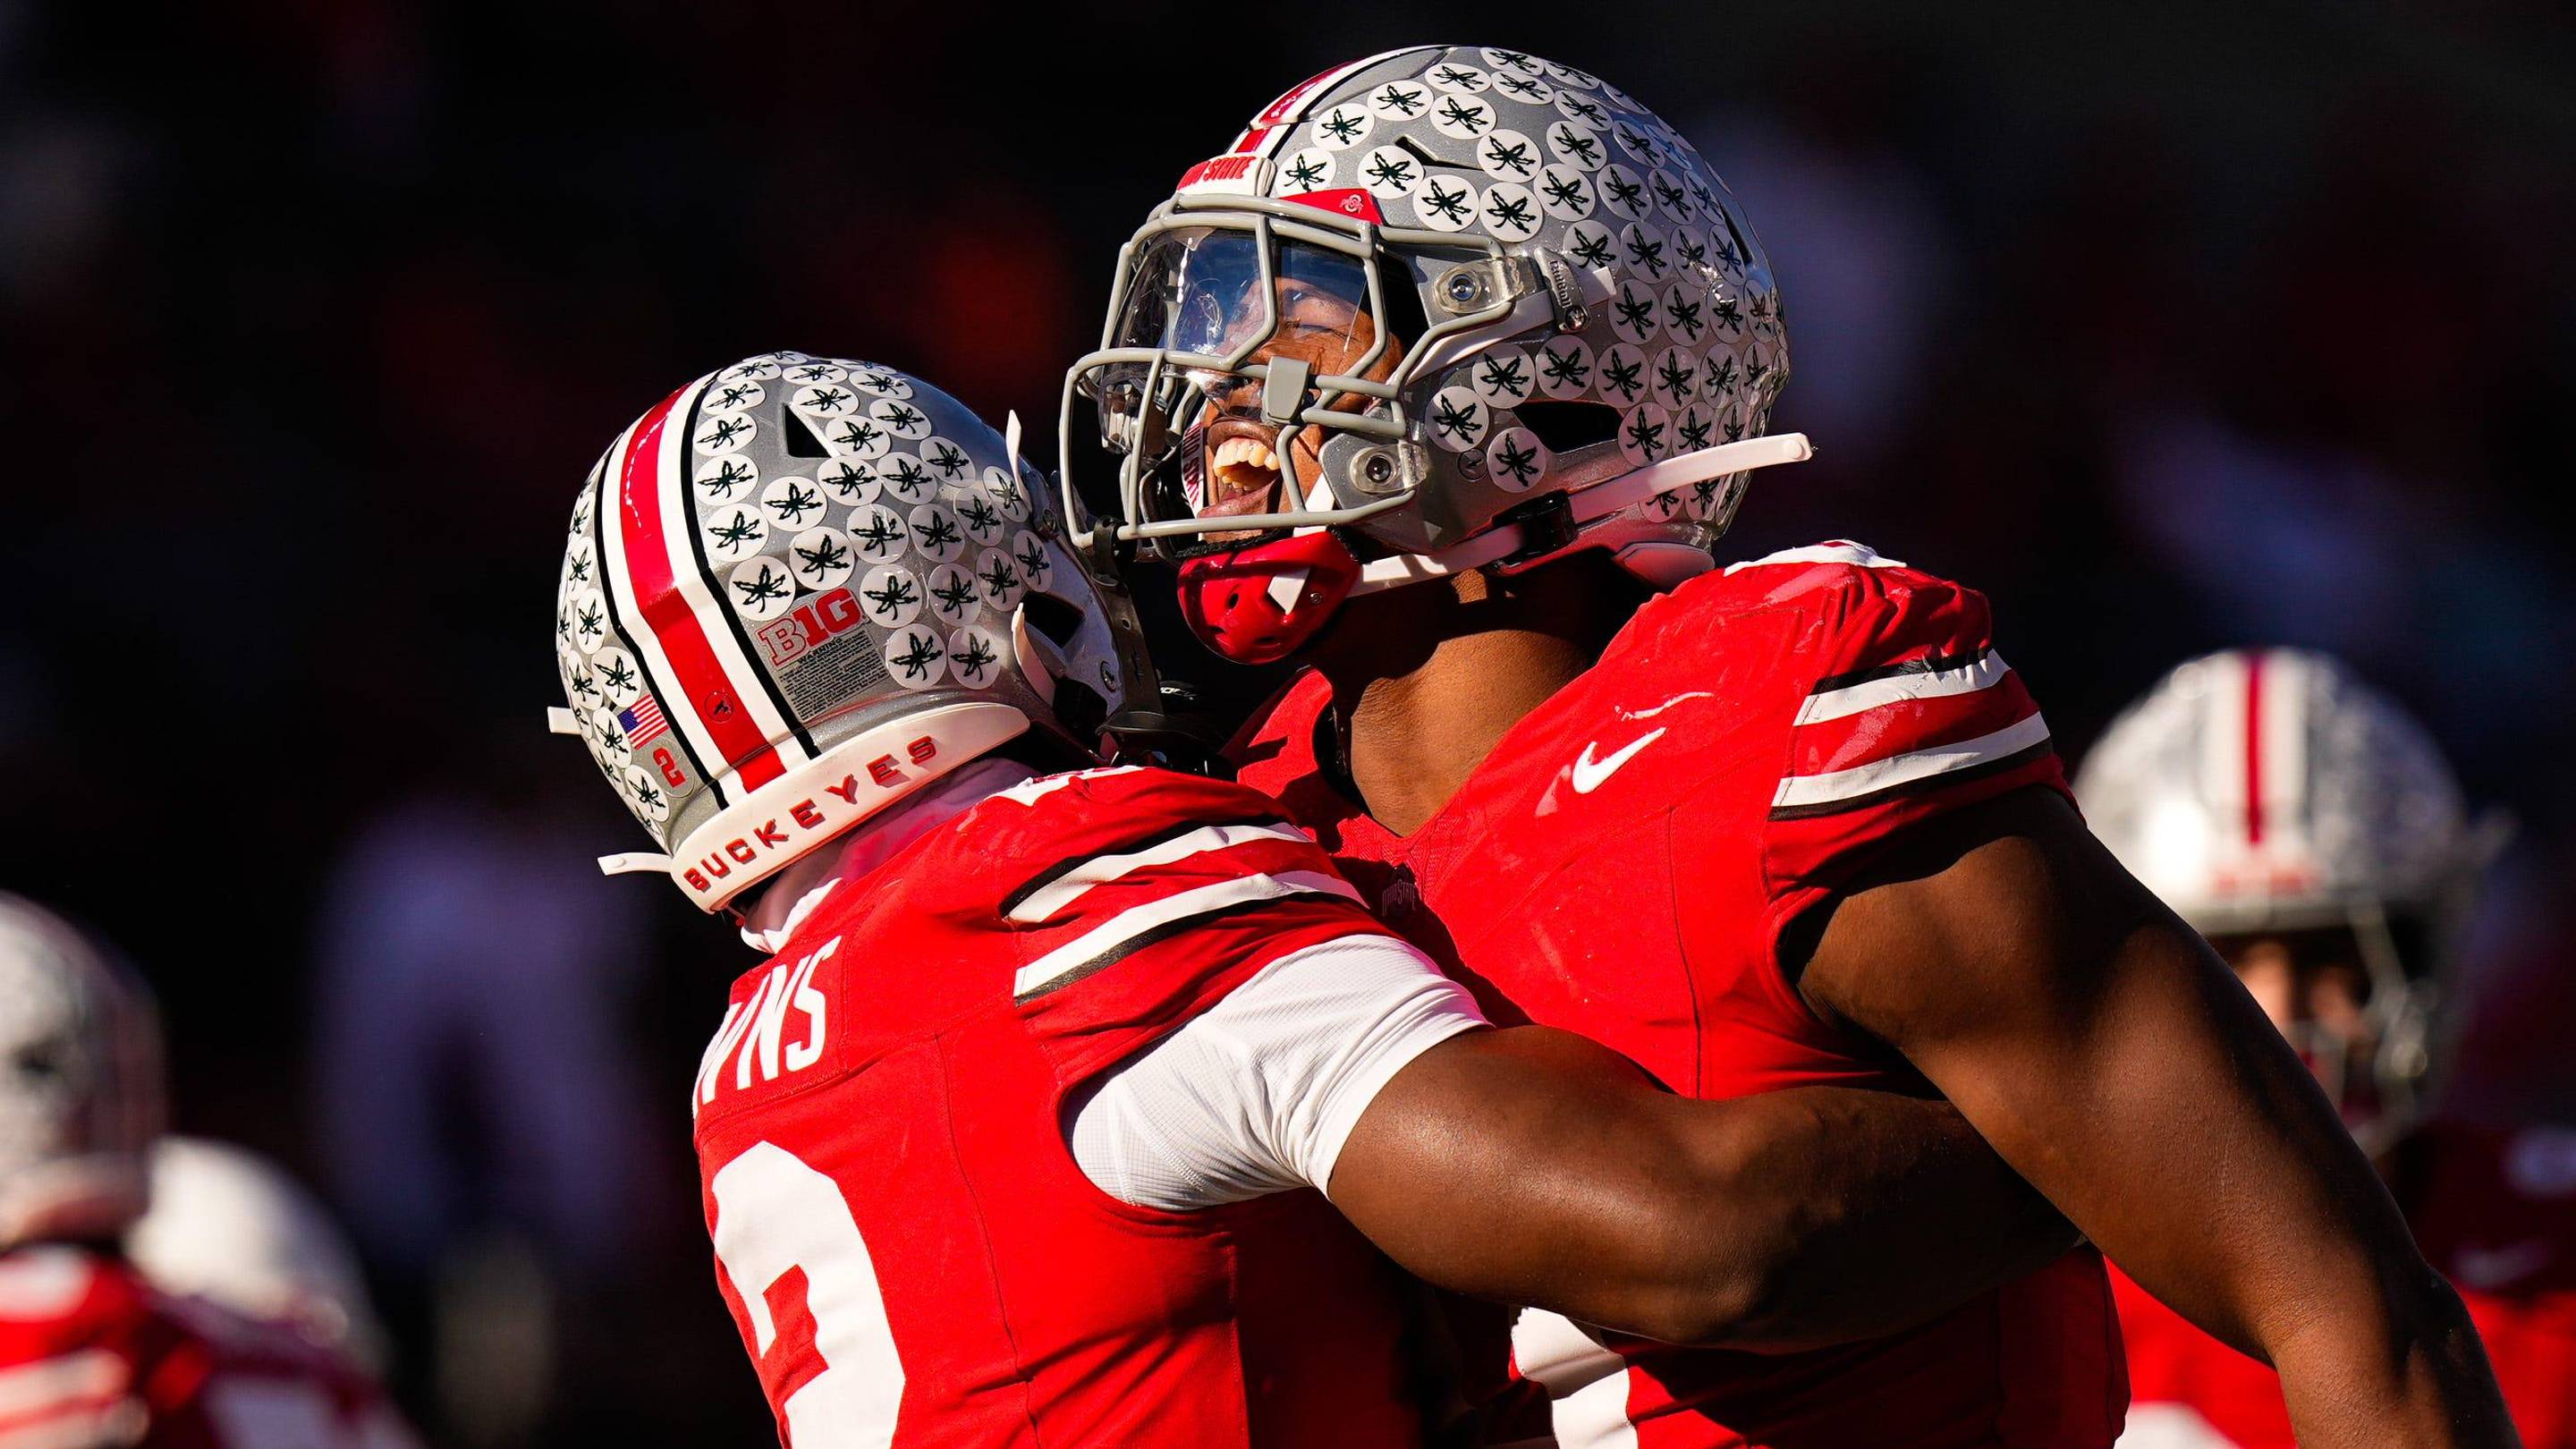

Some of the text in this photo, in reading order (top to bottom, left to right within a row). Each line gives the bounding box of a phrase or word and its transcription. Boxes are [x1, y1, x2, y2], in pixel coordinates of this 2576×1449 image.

[797, 636, 844, 665] WARNING
[652, 747, 687, 788] 2
[682, 735, 937, 892] BUCKEYES
